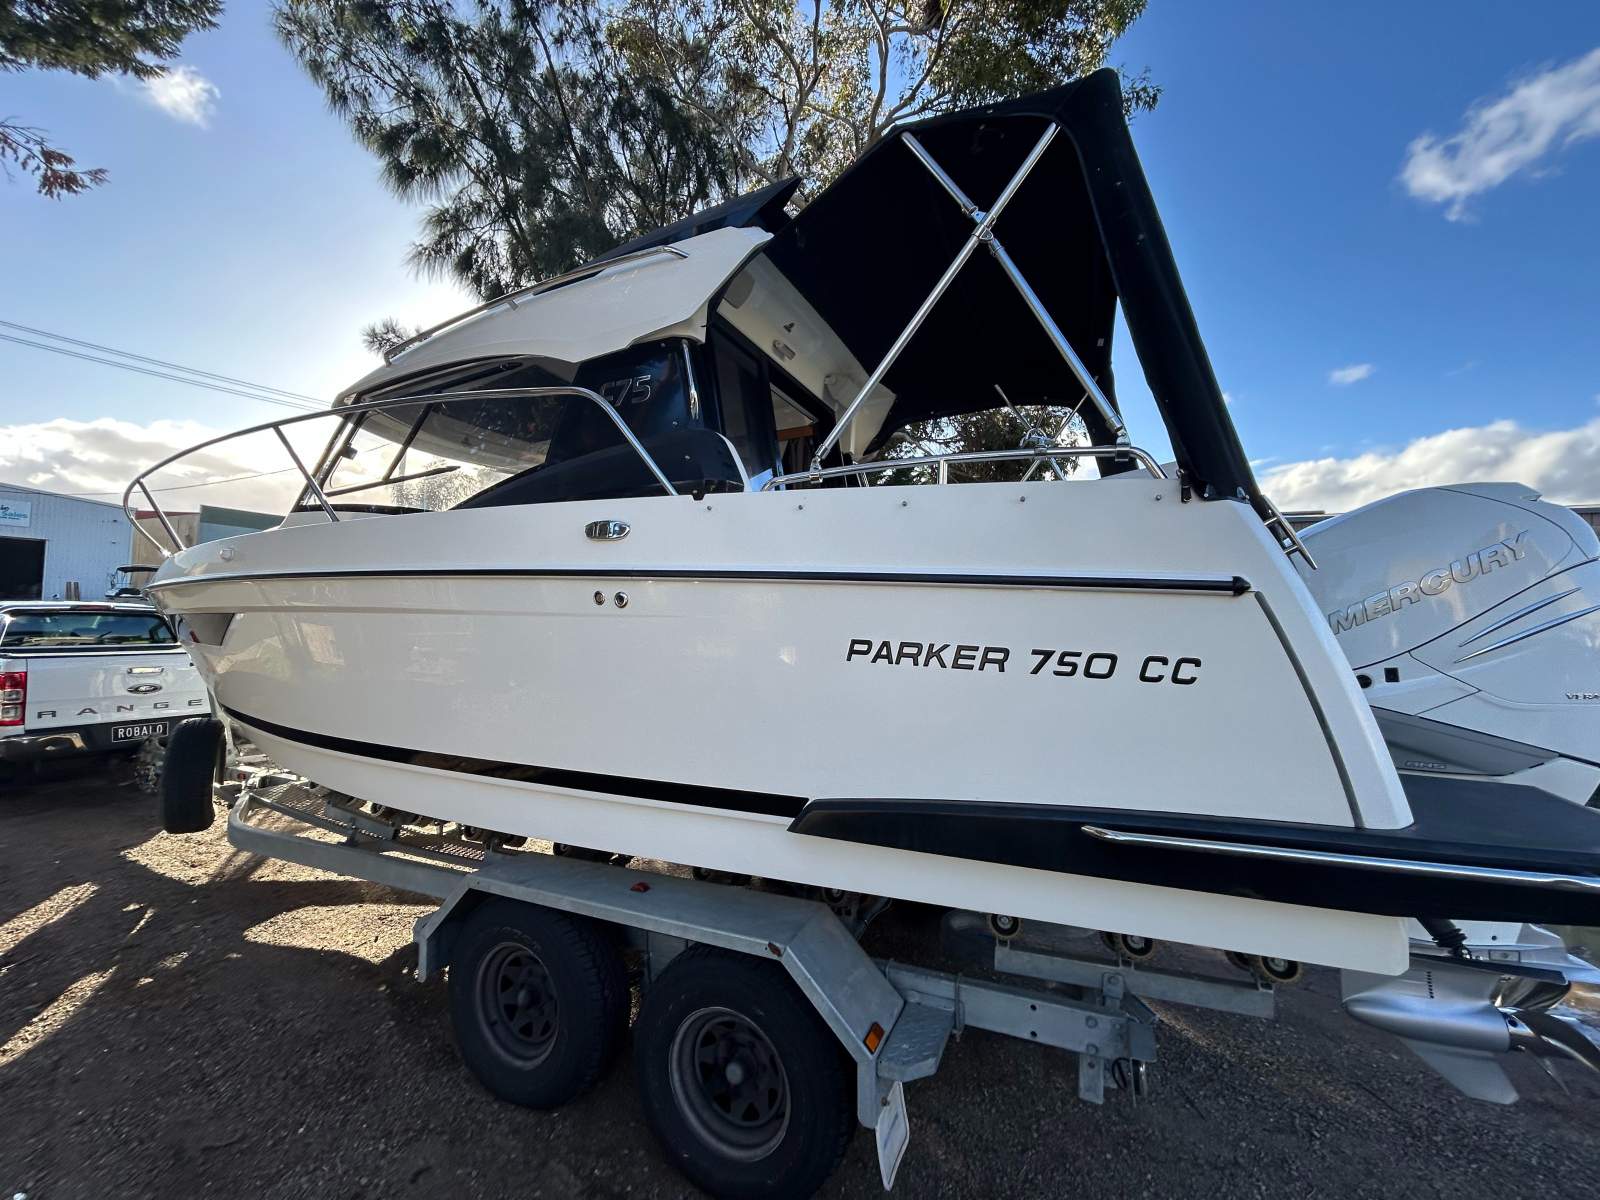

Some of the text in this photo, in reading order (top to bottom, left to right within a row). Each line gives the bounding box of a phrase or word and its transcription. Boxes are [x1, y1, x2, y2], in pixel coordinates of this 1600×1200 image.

[1327, 530, 1528, 635] MERCURY
[846, 639, 1202, 685] PARKER 750 CC
[37, 699, 203, 719] RANGE
[118, 724, 163, 739] ROBALO
